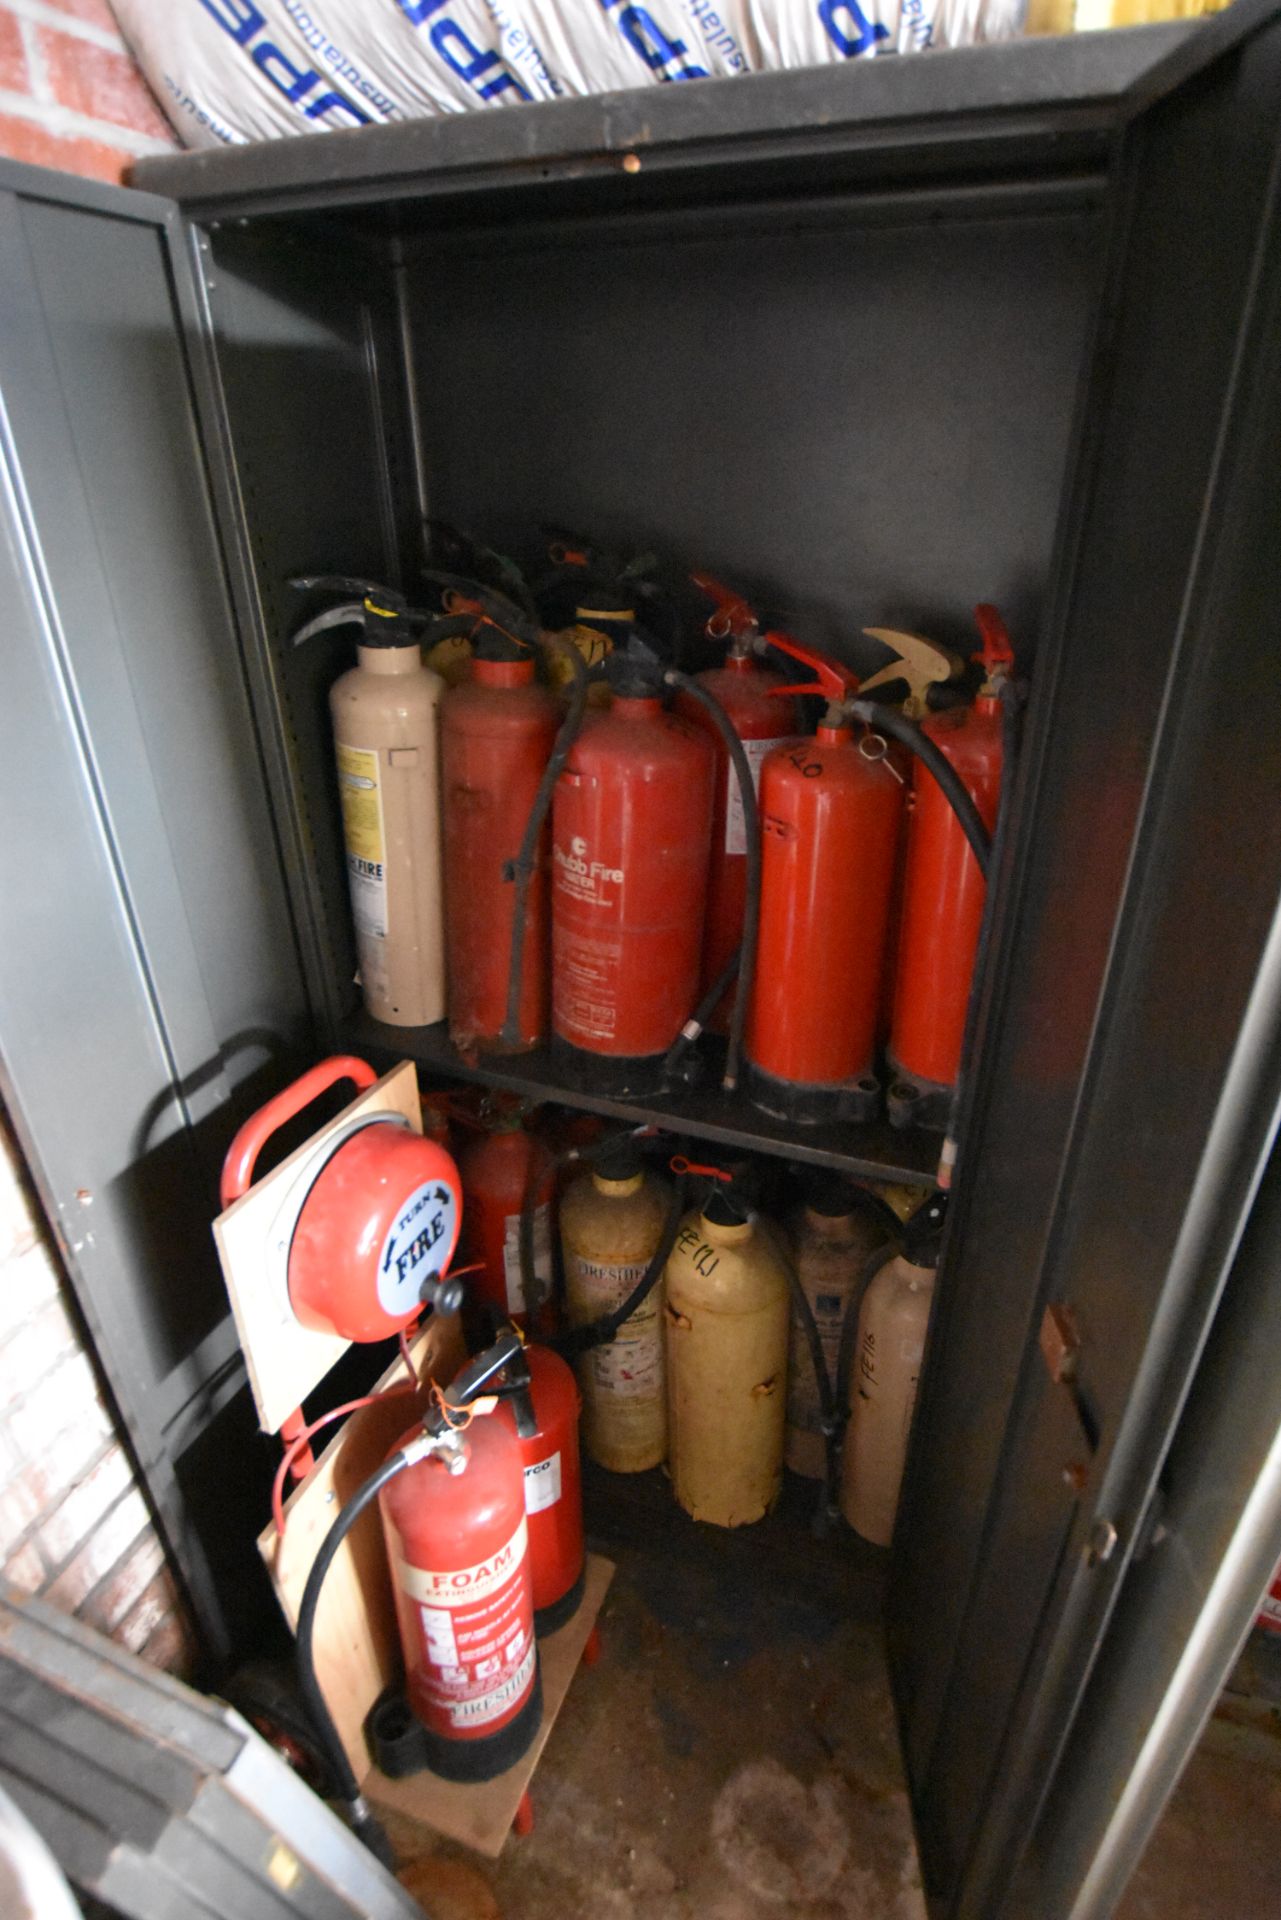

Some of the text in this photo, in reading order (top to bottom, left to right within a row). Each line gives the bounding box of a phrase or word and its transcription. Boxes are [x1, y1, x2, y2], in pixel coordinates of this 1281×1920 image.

[358, 858, 383, 877] FIRE
[590, 861, 625, 884] Fire
[399, 1190, 431, 1231] TURN
[395, 1210, 446, 1284] FIRE
[524, 1461, 551, 1477] rco
[432, 1546, 512, 1589] FOAM
